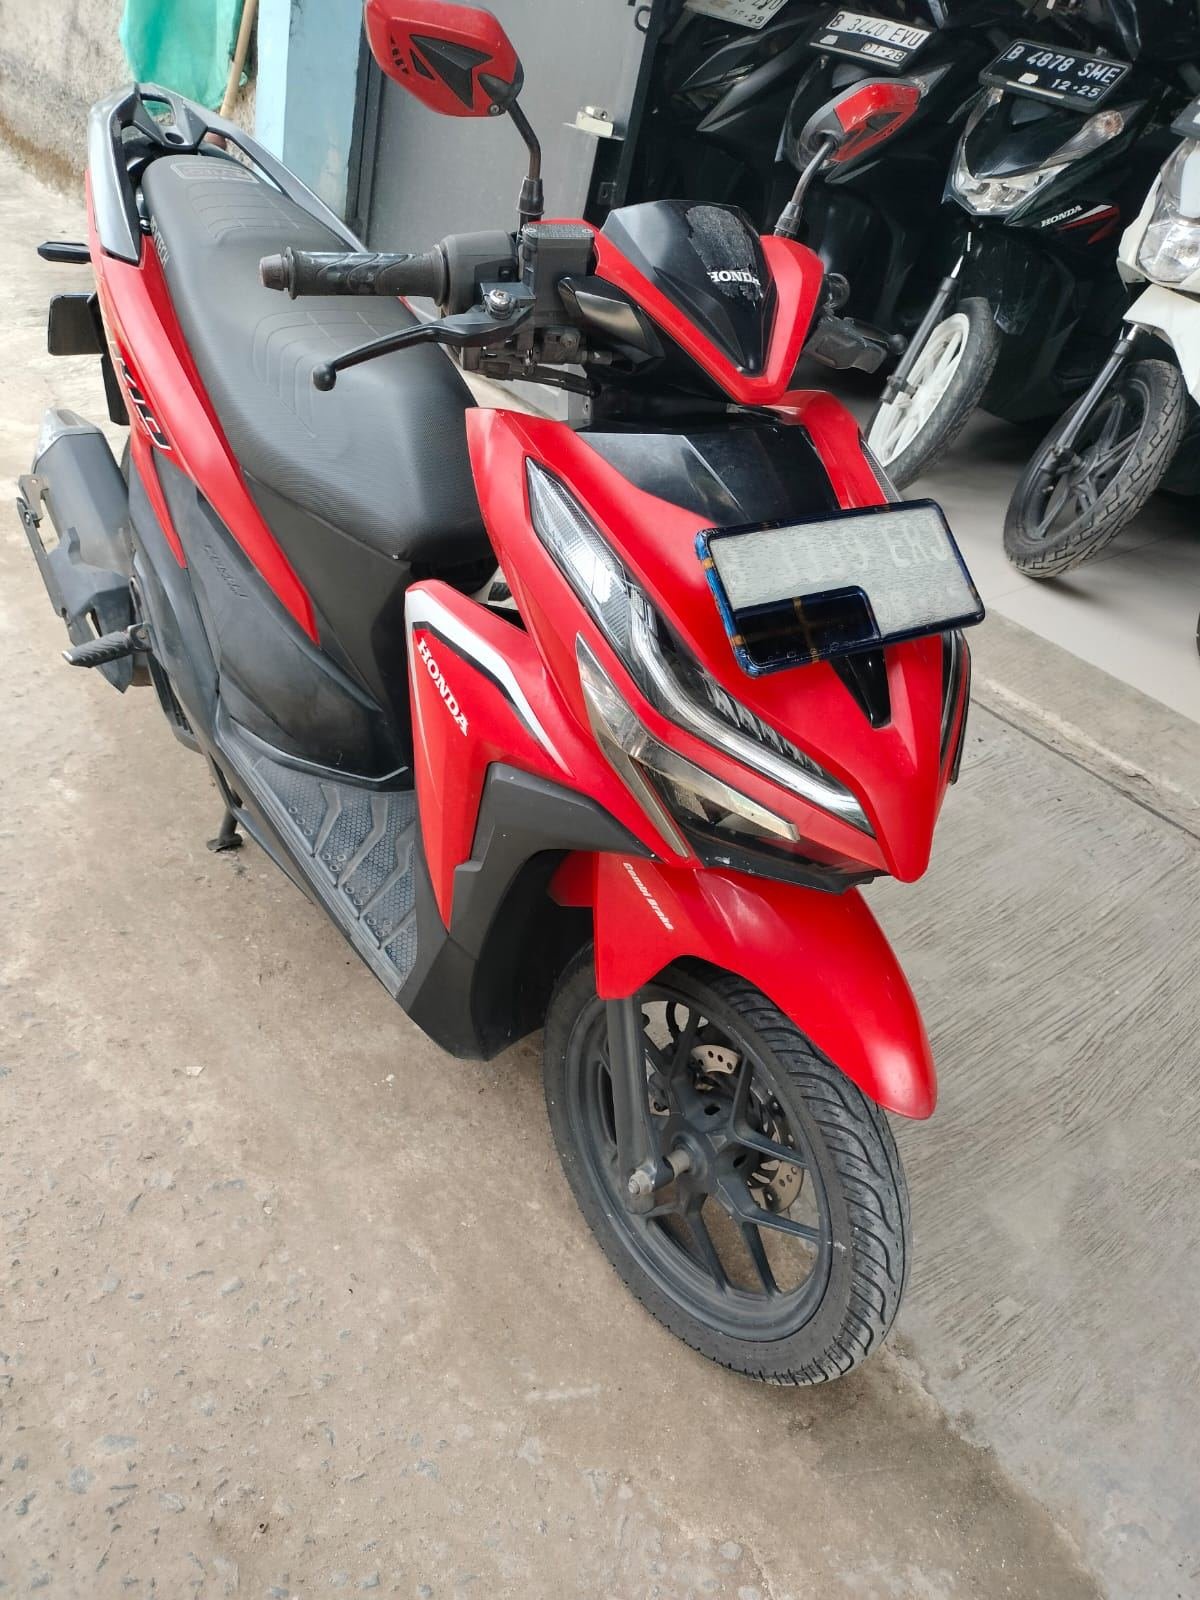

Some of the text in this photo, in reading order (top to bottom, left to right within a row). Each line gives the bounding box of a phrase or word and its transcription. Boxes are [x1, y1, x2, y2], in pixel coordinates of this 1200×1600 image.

[829, 14, 845, 28] B
[846, 18, 889, 37] 3440
[1006, 45, 1121, 83] B 4878 SME
[1040, 204, 1083, 228] HONDA
[417, 637, 469, 737] HONDA
